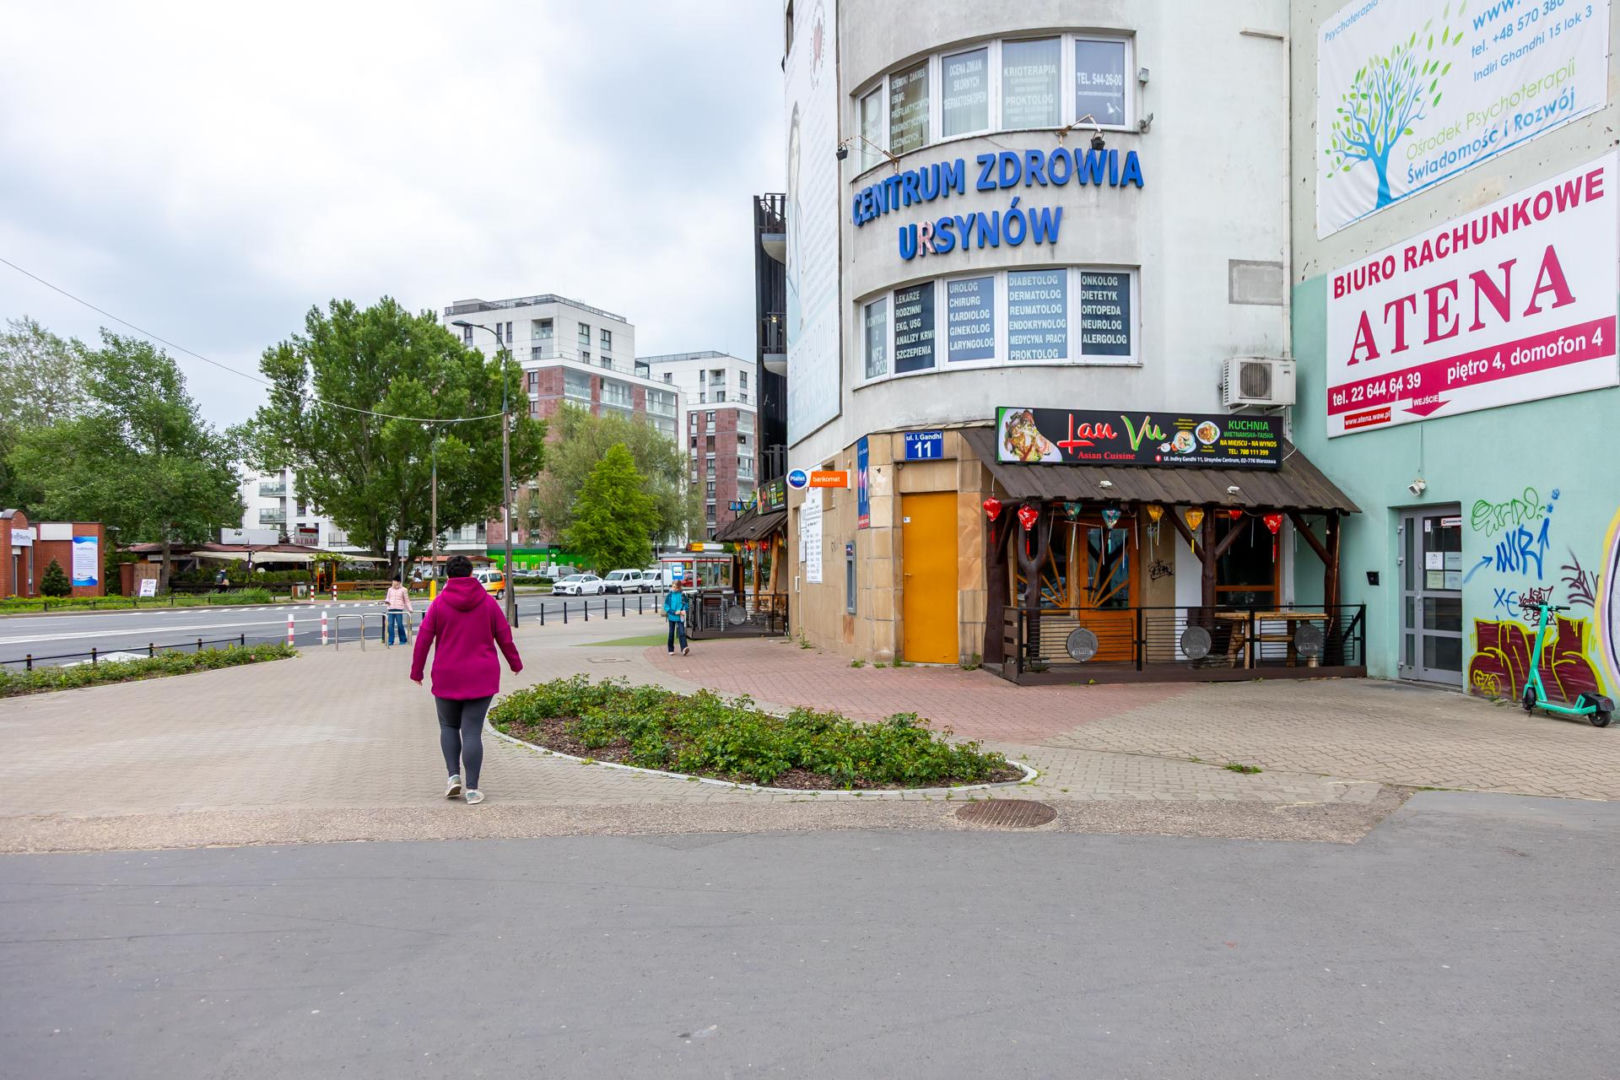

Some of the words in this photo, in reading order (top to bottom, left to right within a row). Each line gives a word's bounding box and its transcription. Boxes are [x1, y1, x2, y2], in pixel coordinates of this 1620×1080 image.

[1471, 41, 1489, 58] tel.
[1493, 24, 1514, 43] +48
[1517, 8, 1540, 32] 570
[1500, 34, 1546, 67] Ghandhi
[1549, 23, 1561, 39] 15
[1564, 12, 1582, 31] lok
[1585, 5, 1593, 18] 3
[1003, 64, 1056, 77] KRIOTERAPIA
[1077, 71, 1090, 85] TEL.
[1005, 94, 1053, 106] PROKTOLOG
[1405, 122, 1461, 161] Ośrodek
[1466, 57, 1576, 131] Psychoterapii
[1407, 123, 1499, 184] Świadomość
[1503, 120, 1509, 137] i
[1514, 86, 1576, 132] Rozwój
[851, 158, 966, 228] CENTRUM
[976, 147, 1145, 192] ZDROWIA
[898, 196, 1064, 261] URSYNÓW
[1333, 254, 1396, 300] BIURO
[1403, 167, 1605, 272] RACHUNKOWE
[1009, 275, 1058, 287] DIABETOLOG
[1081, 276, 1118, 287] ONKOLOG
[949, 282, 979, 294] UROLOG
[895, 290, 920, 305] LEKARZE
[1009, 289, 1062, 301] DERMATOLOG
[1081, 290, 1118, 301] DIETETYK
[950, 296, 981, 308] CHIRURG
[1347, 244, 1577, 366] ATENA
[895, 304, 922, 318] RODZINNI
[950, 309, 990, 322] KARDIOLOG
[1009, 304, 1062, 316] REUMATOLOG
[1081, 305, 1121, 316] ORTOPEDA
[896, 321, 909, 332] EKG,
[910, 318, 921, 329] USG
[950, 323, 990, 336] GINEKOLOG
[1009, 319, 1067, 330] ENDOKRYNOLOG
[1081, 320, 1122, 330] NEUROLOG
[896, 332, 920, 346] ANALIZY
[950, 337, 994, 351] LARYNGOLOG
[1009, 334, 1043, 345] MEDYCYNA
[1046, 333, 1066, 344] PRACY
[1082, 334, 1127, 344] ALERGOLOG
[896, 345, 932, 360] SZCZEPIENIA
[1010, 349, 1059, 360] PROKTOLOG
[1447, 358, 1489, 384] piętro
[1492, 352, 1506, 371] 4,
[1510, 335, 1587, 367] domofon
[1591, 327, 1604, 347] 4
[1333, 392, 1349, 407] tel.
[1351, 386, 1364, 401] 22
[1366, 382, 1386, 399] 644
[1389, 378, 1404, 395] 64
[1406, 372, 1421, 389] 39
[1413, 393, 1440, 407] WEJŚCIE
[1228, 420, 1270, 431] KUCHNIA
[920, 432, 942, 441] Gandhi
[1120, 415, 1167, 451] Vu
[914, 441, 931, 458] 11
[1078, 452, 1102, 460] Asian
[1103, 451, 1136, 460] Cuisine
